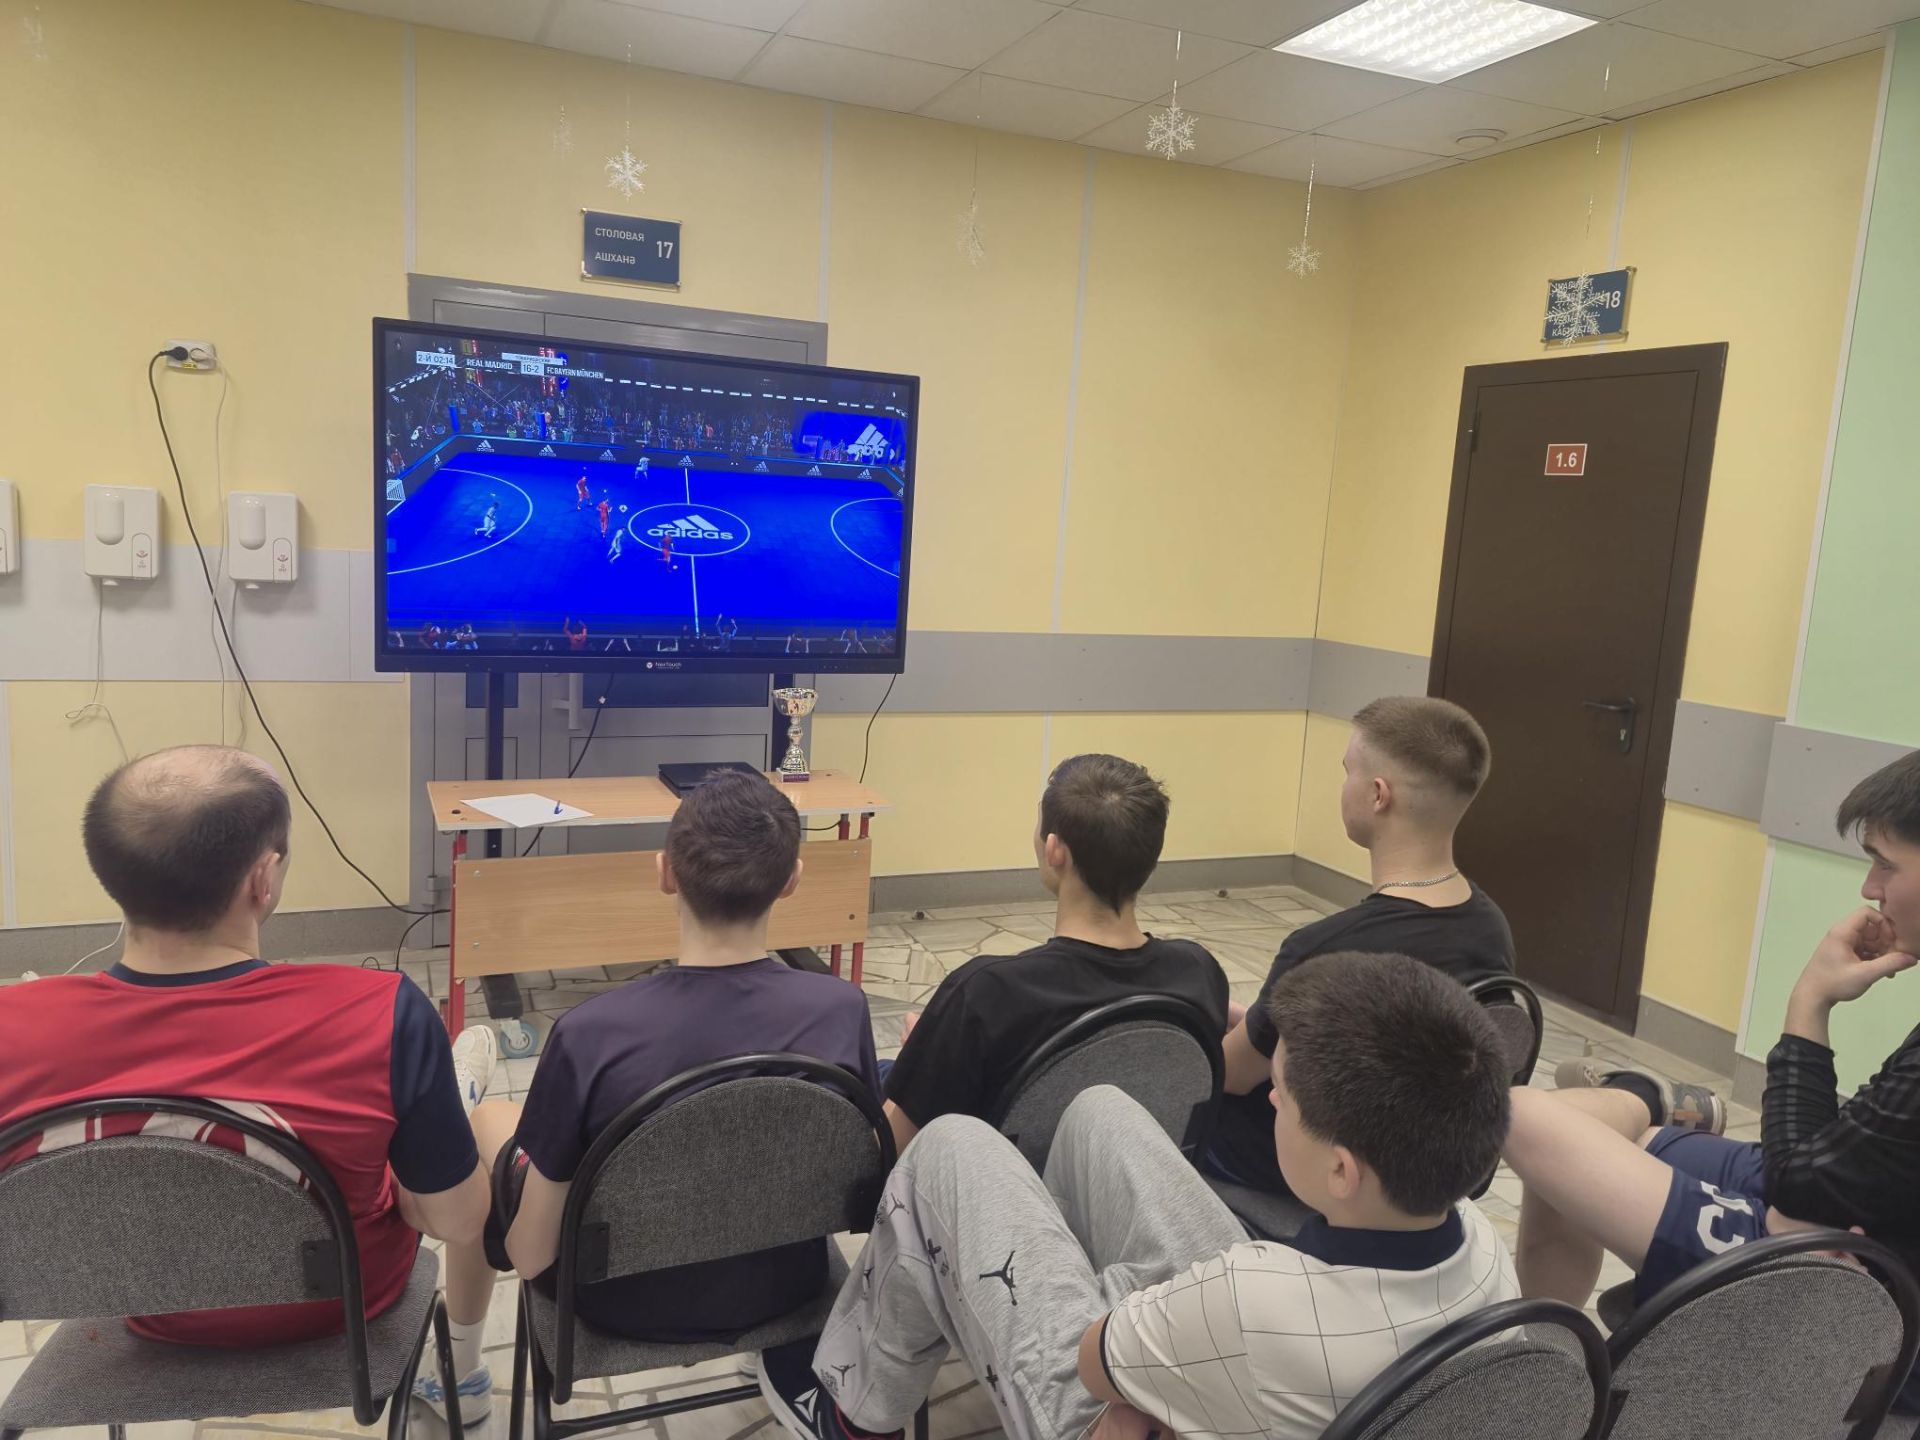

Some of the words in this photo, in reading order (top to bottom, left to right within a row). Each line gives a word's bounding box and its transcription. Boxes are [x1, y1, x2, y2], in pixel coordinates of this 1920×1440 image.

[594, 227, 645, 242] СТОЛОВАЯ
[656, 240, 674, 259] 17
[1604, 290, 1621, 309] 18
[434, 355, 453, 364] 02:14
[466, 359, 484, 367] REAL
[485, 360, 513, 370] MADRID
[522, 364, 539, 373] 16-2
[547, 366, 555, 374] FC
[555, 367, 576, 377] BAYERN
[1556, 452, 1578, 468] 1.6
[646, 526, 734, 540] adidas
